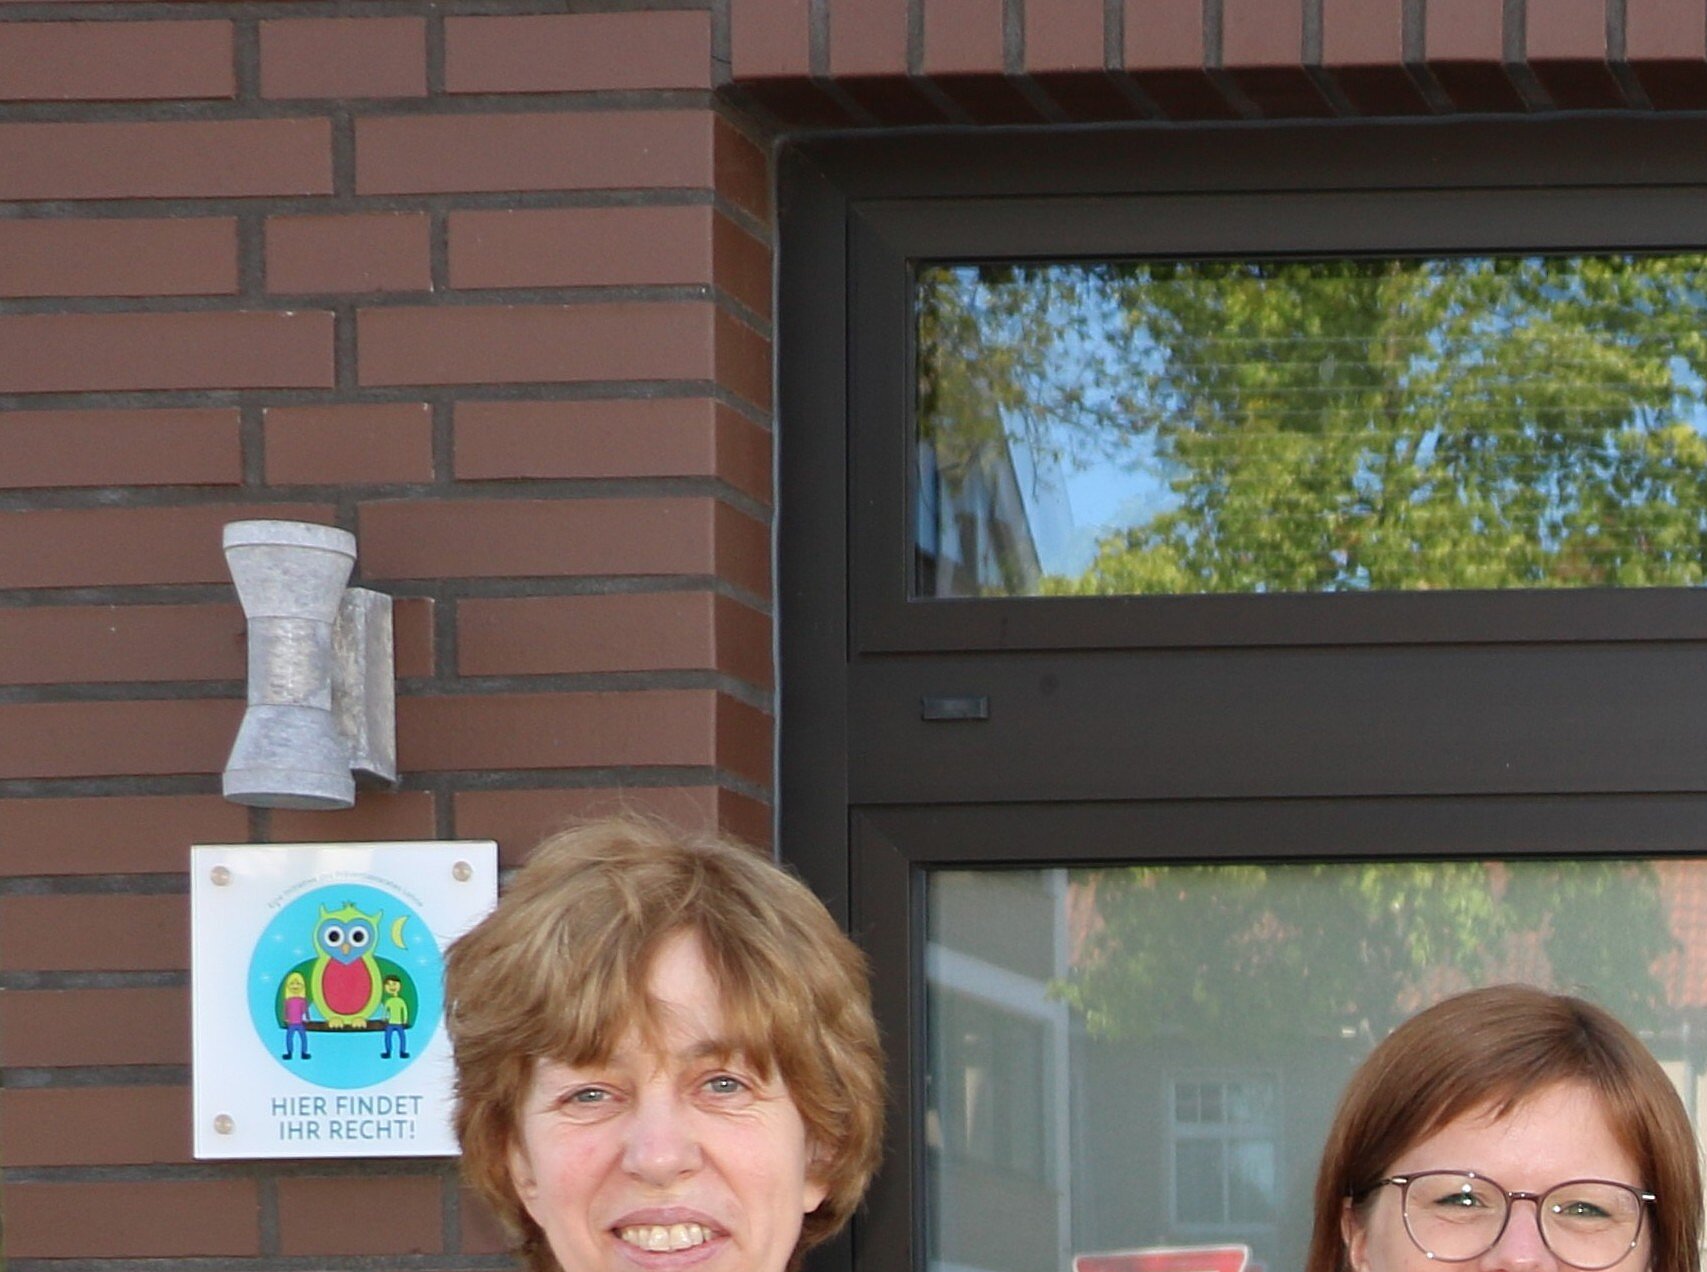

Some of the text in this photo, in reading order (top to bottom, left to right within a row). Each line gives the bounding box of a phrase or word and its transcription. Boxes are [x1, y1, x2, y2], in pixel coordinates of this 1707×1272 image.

[272, 1095, 424, 1117] HIER FINDET
[279, 1119, 416, 1141] IHR RECHT!
